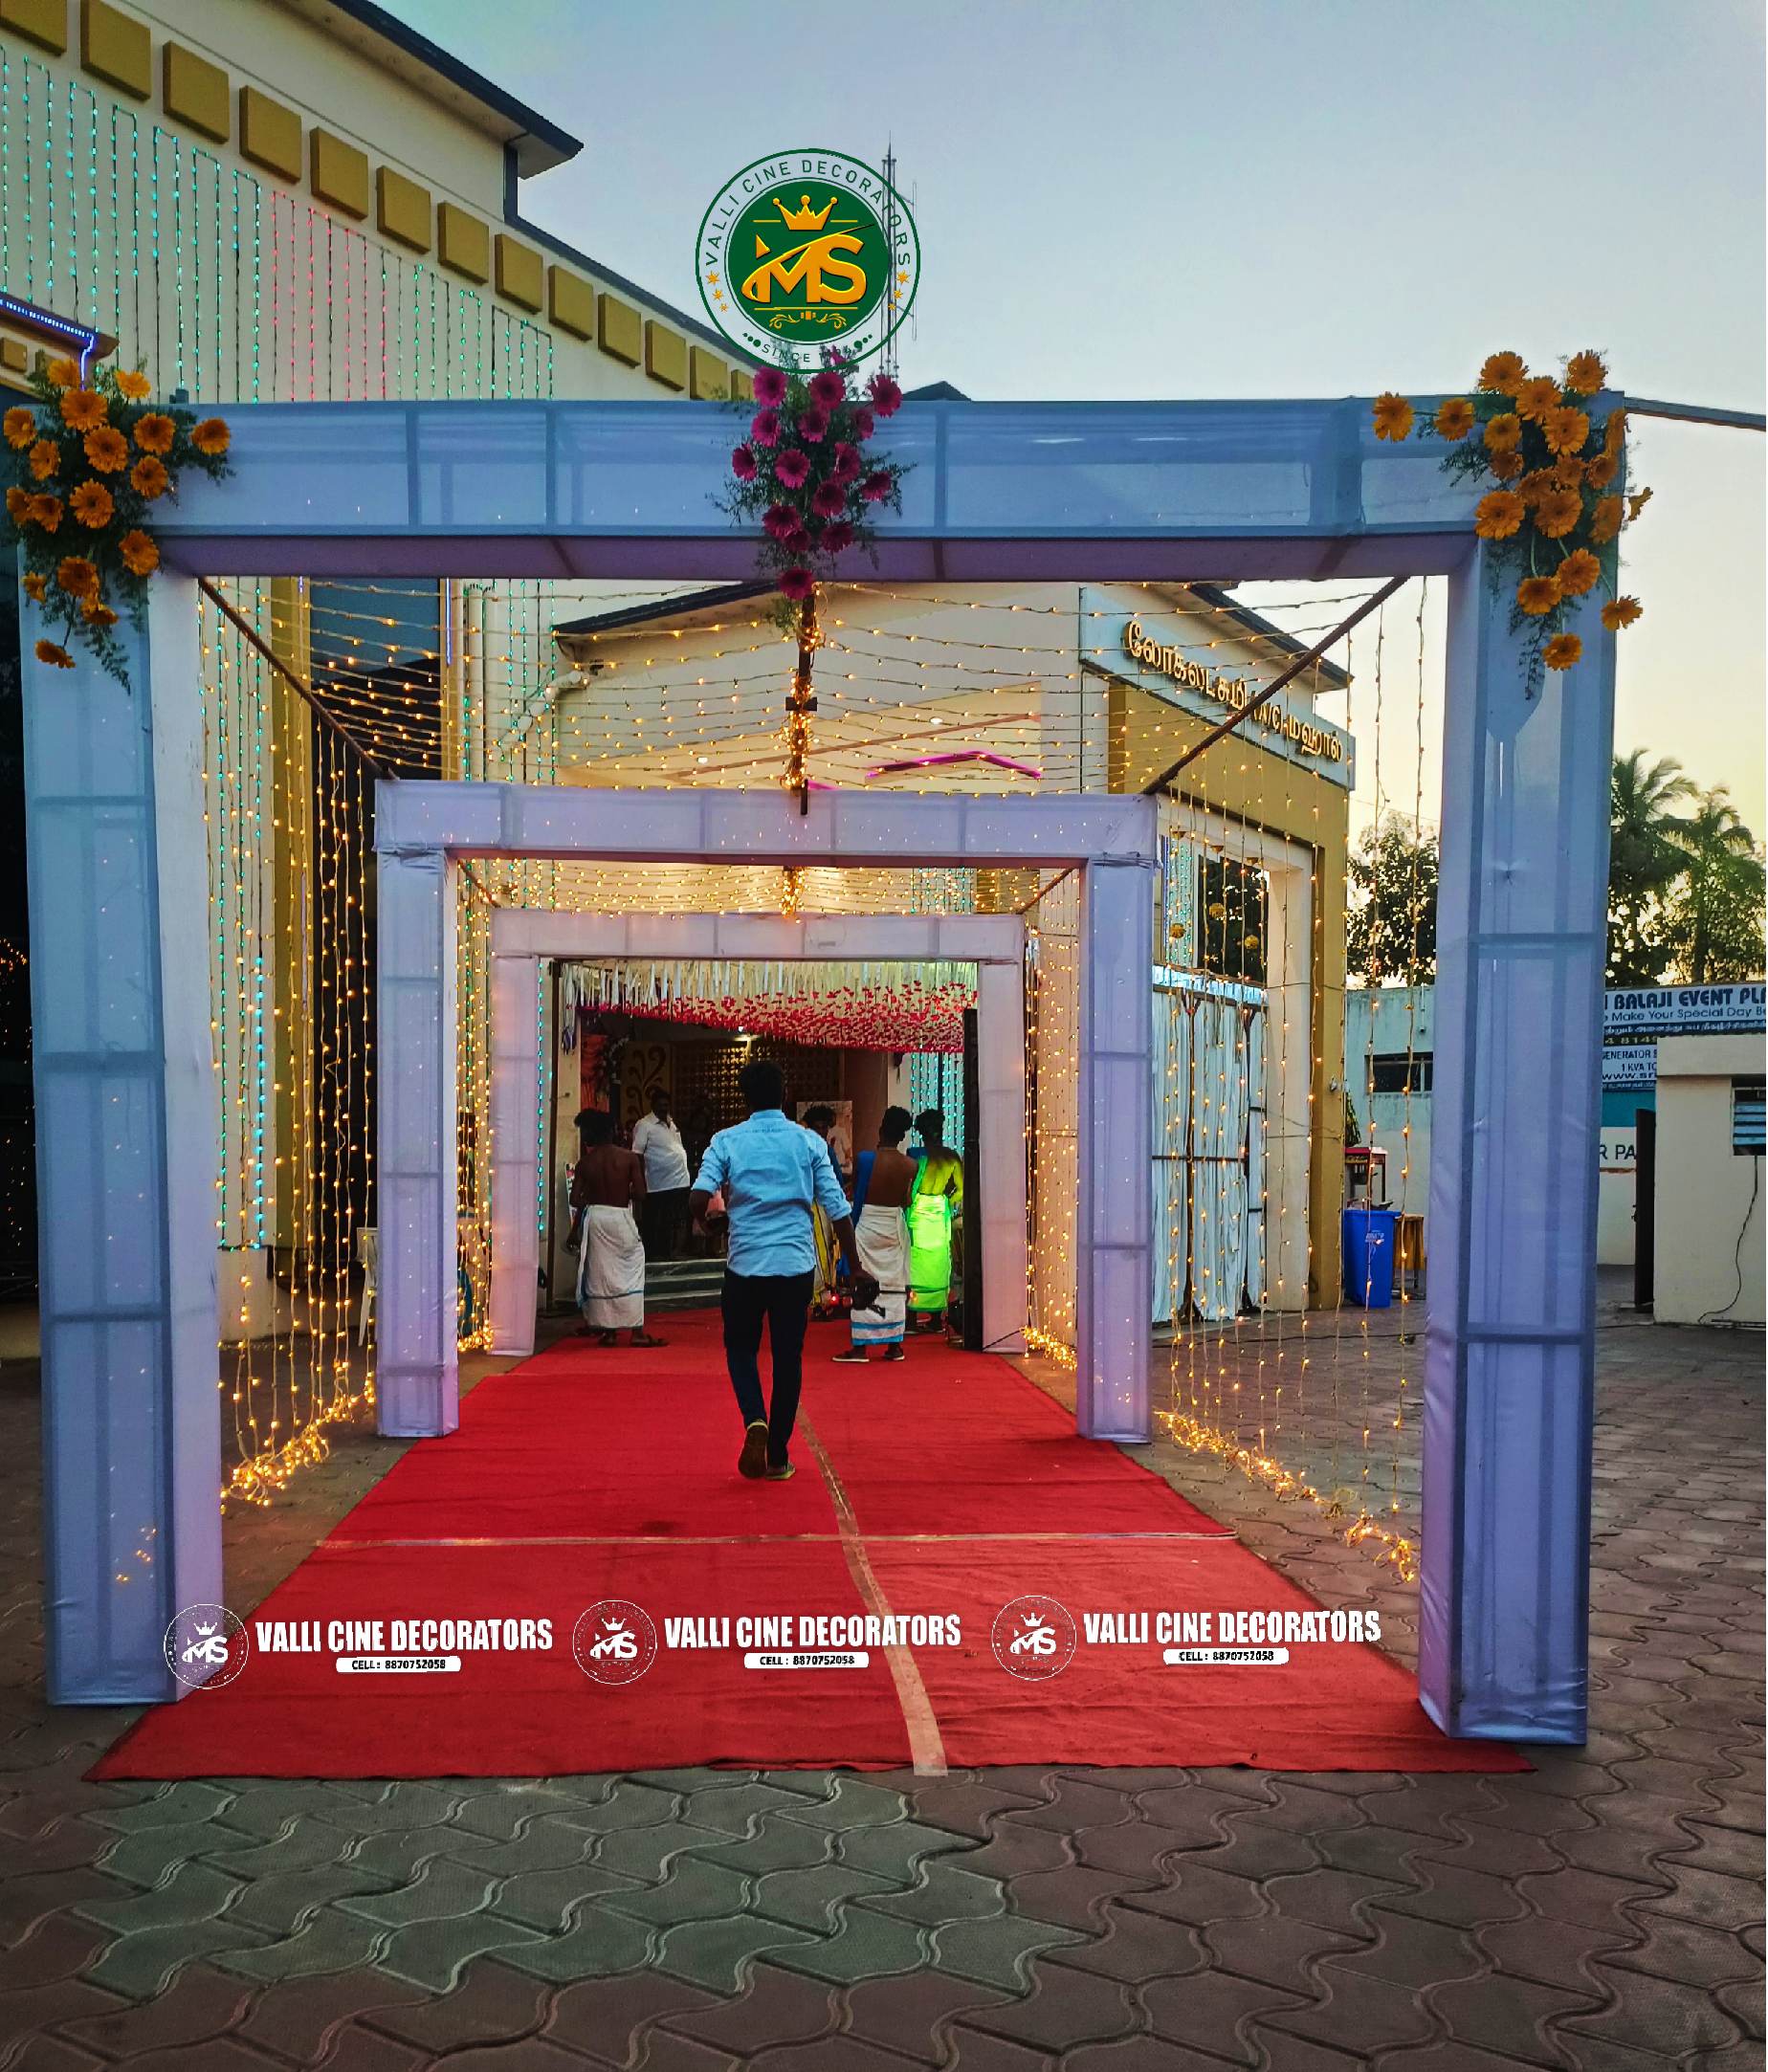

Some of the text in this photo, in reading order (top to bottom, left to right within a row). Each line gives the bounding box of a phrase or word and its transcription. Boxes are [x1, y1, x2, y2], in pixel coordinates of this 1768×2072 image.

[1614, 992, 1672, 1010] BALAJI
[1679, 988, 1734, 1007] EVENT
[1611, 1011, 1645, 1022] Make
[1647, 1010, 1673, 1021] Your
[1677, 1007, 1724, 1021] Special
[1727, 1006, 1752, 1018] Day
